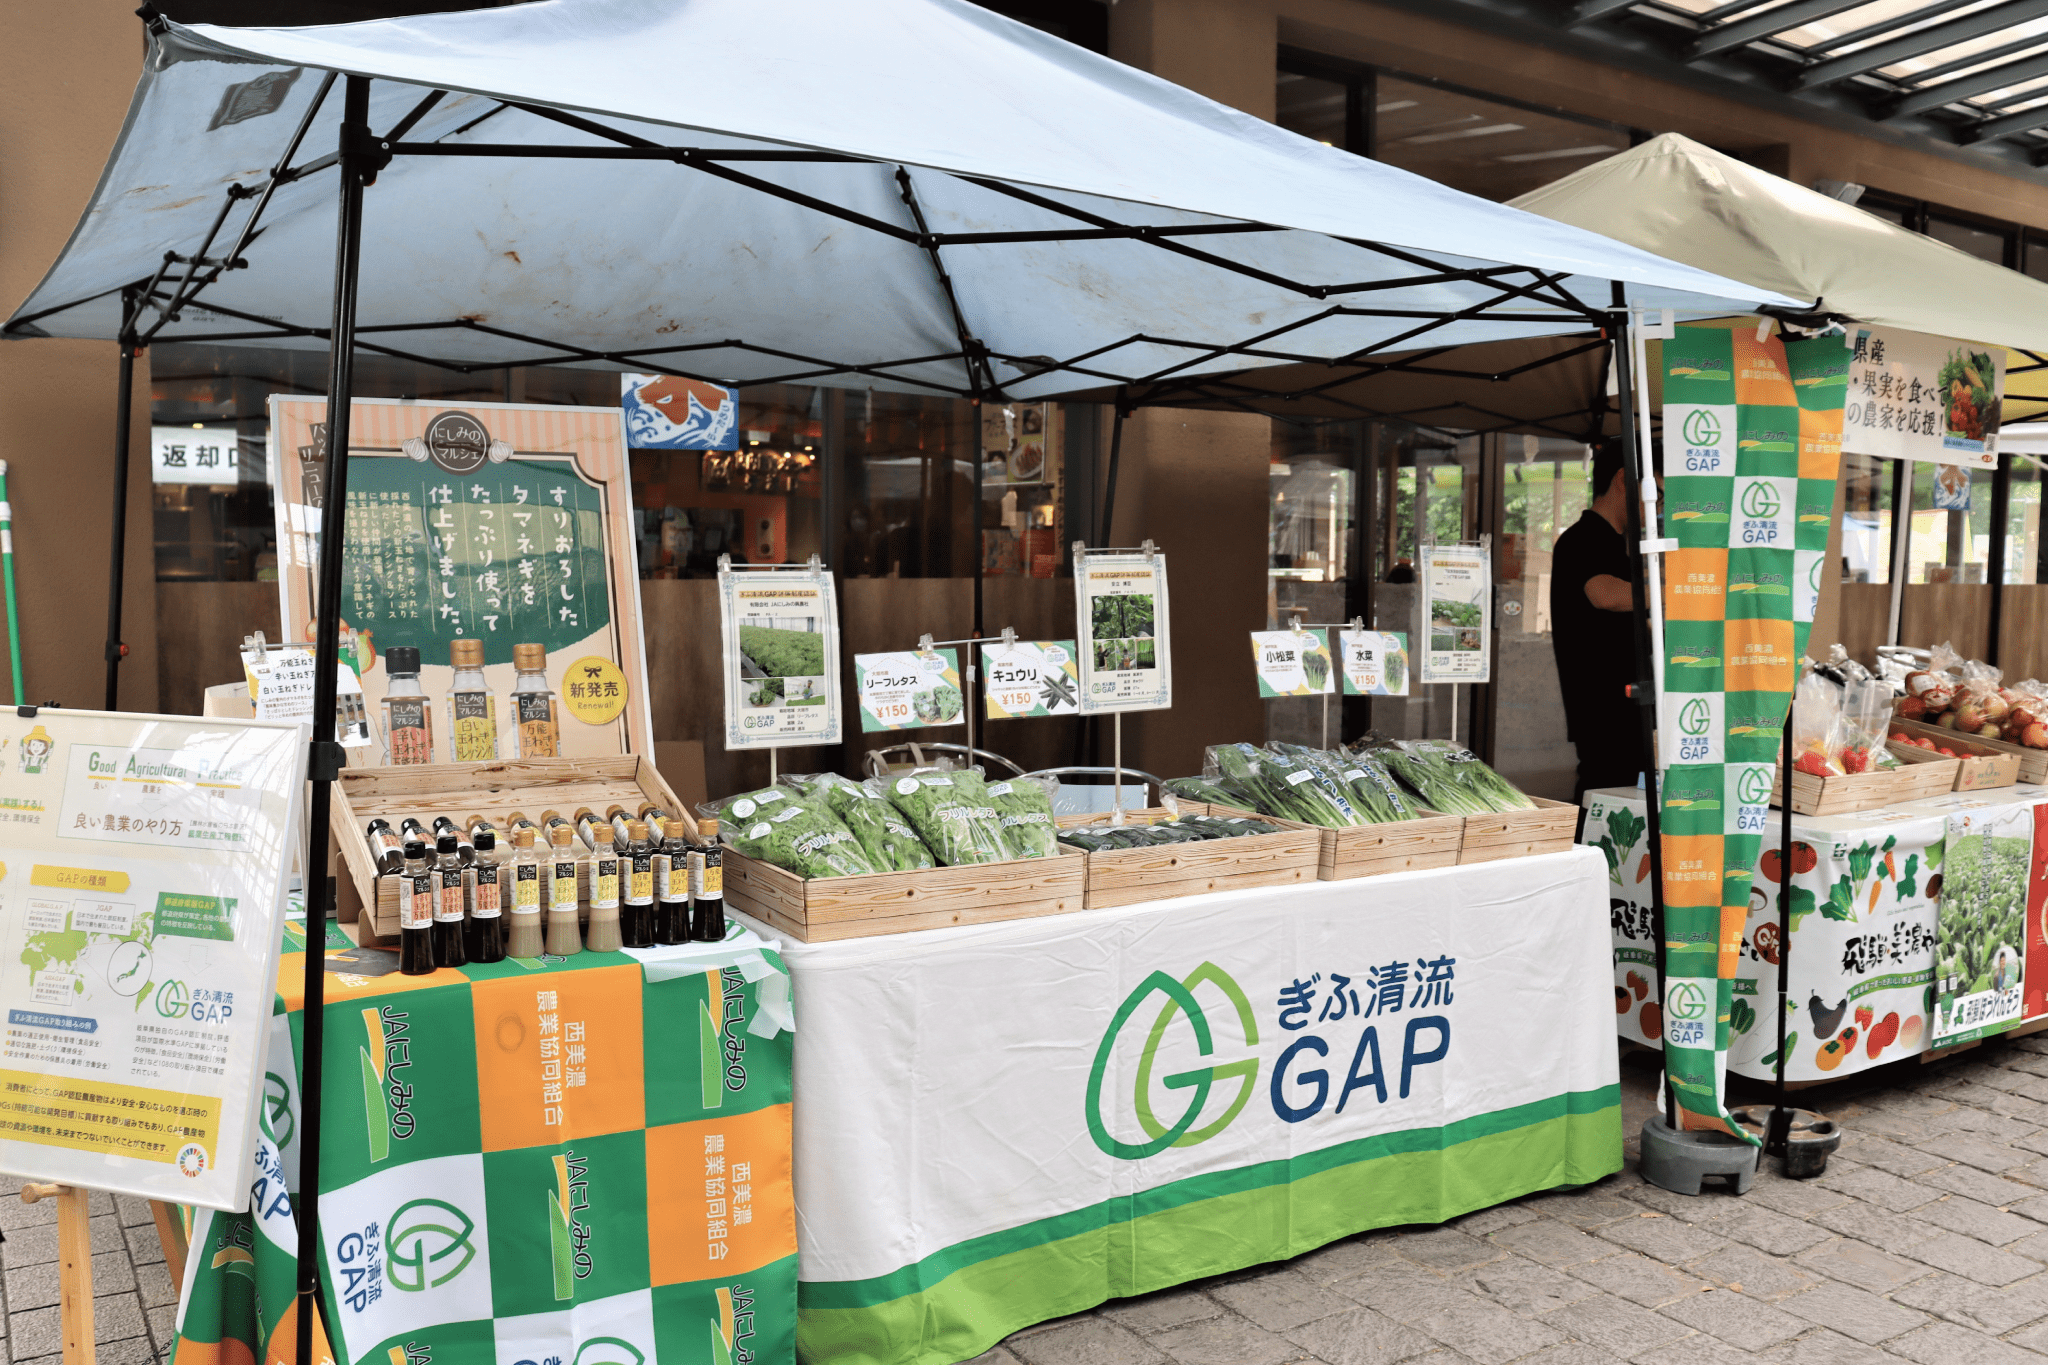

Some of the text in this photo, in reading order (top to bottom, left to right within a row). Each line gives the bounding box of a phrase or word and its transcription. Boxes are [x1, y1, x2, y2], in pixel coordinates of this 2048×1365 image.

[1853, 336, 1885, 366] 県産
[434, 426, 481, 446] にしみの
[436, 448, 480, 460] マルシェ
[1686, 449, 1720, 458] ぎふ清流
[1686, 458, 1721, 471] GAP
[1743, 520, 1777, 530] ぎふ清流
[1742, 530, 1777, 543] GAP
[512, 486, 537, 605] タマネギを
[429, 484, 464, 635] 仕上げました。
[471, 484, 500, 632] たっぷり使って
[549, 486, 578, 626] すりおろした
[1266, 651, 1295, 663] 小松菜
[1356, 650, 1373, 661] 水菜
[866, 676, 918, 688] リーフレタス
[993, 669, 1036, 682] キュウリ
[1355, 675, 1375, 685] ¥150
[570, 681, 619, 698] 新発売
[457, 693, 485, 705] にしみの
[521, 699, 547, 711] にしみの
[1002, 692, 1031, 705] ¥150
[393, 705, 421, 716] にしみの
[458, 708, 483, 716] マルシェ
[523, 711, 546, 719] マルシェ
[876, 704, 908, 718] ¥150
[395, 717, 420, 726] マルシェ
[461, 720, 483, 732] 白い
[398, 731, 420, 742] 辛い
[526, 724, 547, 735] 万能
[457, 732, 489, 745] 玉ねぎ
[523, 736, 553, 748] 玉ねぎ
[393, 743, 426, 755] 玉ねぎ
[1680, 746, 1709, 760] GAP
[88, 752, 116, 774] Good
[125, 754, 187, 779] Agricultural
[938, 806, 998, 822] フリルレタス
[74, 811, 183, 836] 良い農業のやり方
[56, 872, 107, 887] GAPの種類
[96, 904, 113, 912] JGAP
[193, 988, 234, 1004] ぎふ清流
[1277, 954, 1456, 1031] ぎふ清流
[191, 1002, 232, 1024] GAP
[723, 967, 748, 1091] JAにしみの
[1670, 1030, 1704, 1044] GAP
[536, 990, 564, 1126] 農業協同組合
[563, 1020, 587, 1089] 西美濃
[382, 1005, 416, 1139] JAにしみの
[1270, 1015, 1451, 1124] GAP
[704, 1134, 729, 1261] 農業協同組合
[731, 1161, 752, 1226] 西美濃
[566, 1151, 593, 1279] JAにしみの
[364, 1221, 383, 1304] ぎふ清流
[337, 1232, 368, 1314] GAP
